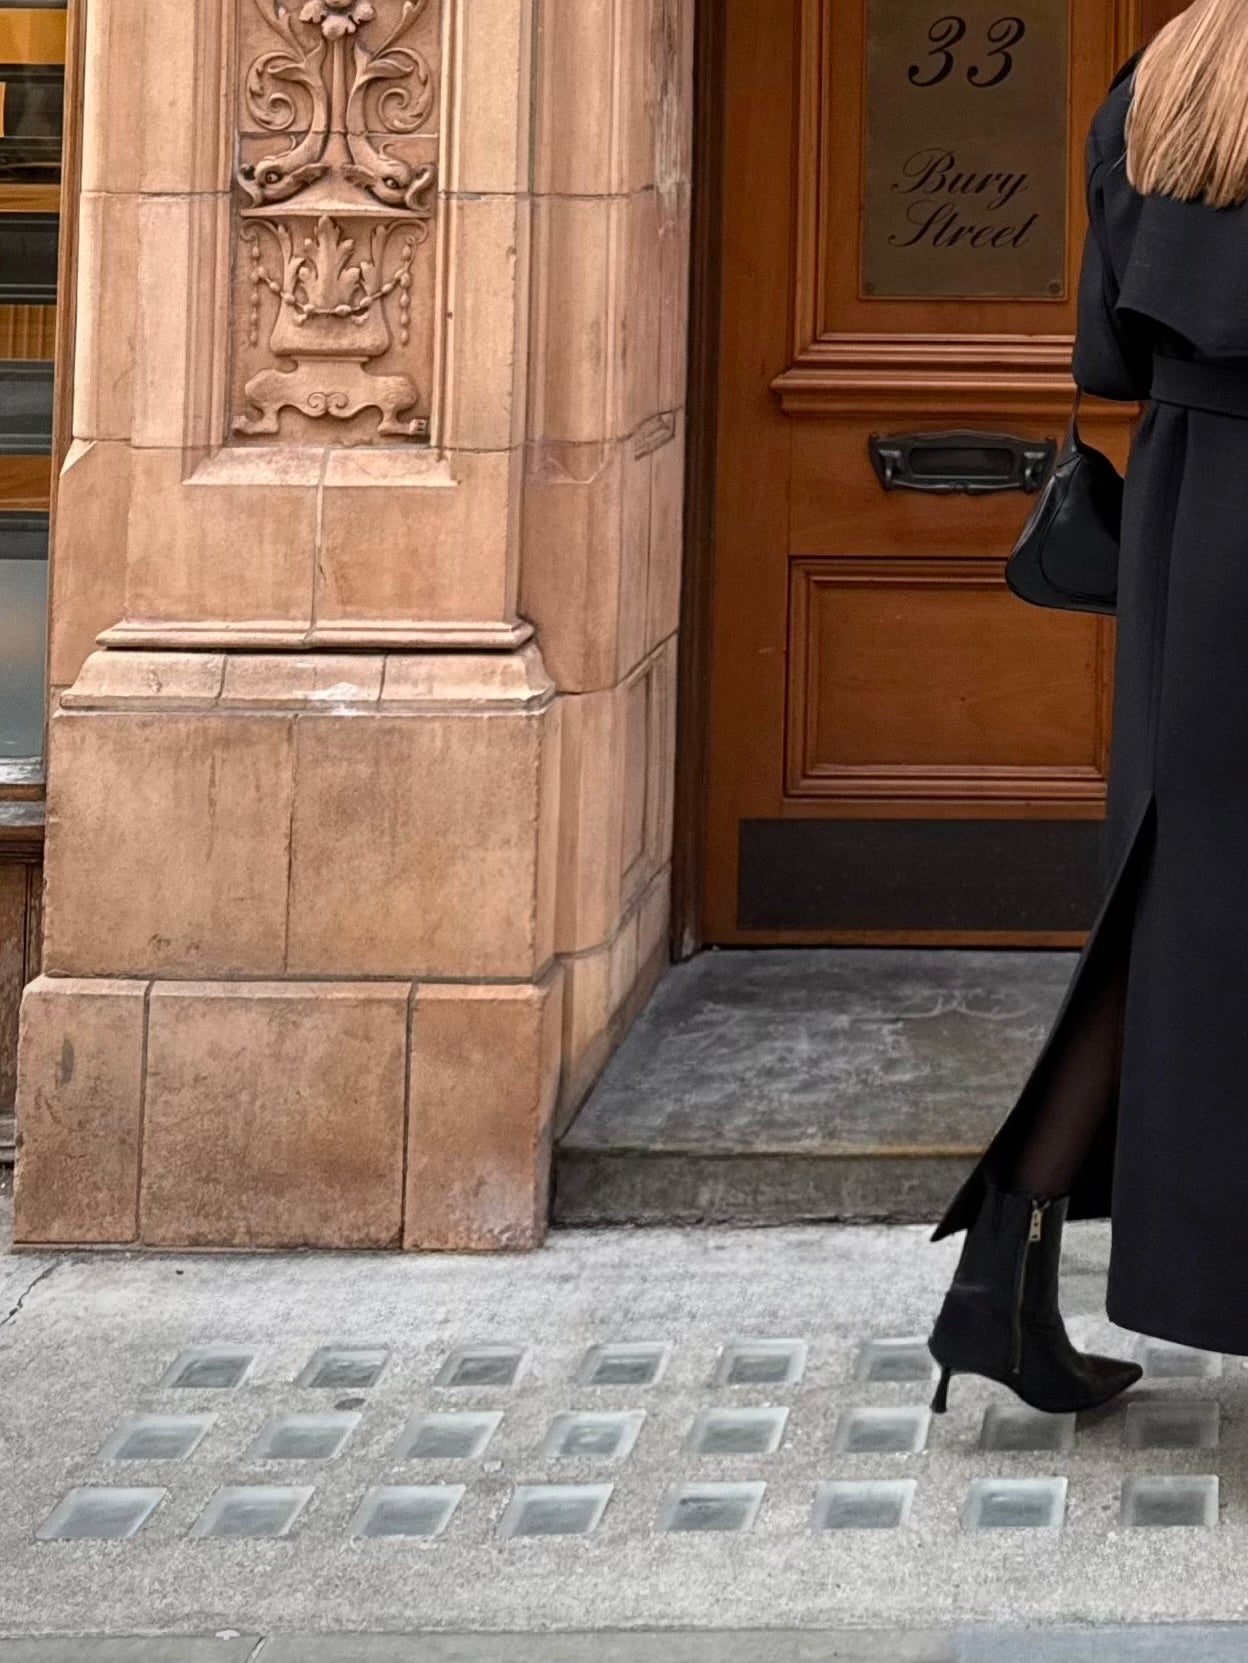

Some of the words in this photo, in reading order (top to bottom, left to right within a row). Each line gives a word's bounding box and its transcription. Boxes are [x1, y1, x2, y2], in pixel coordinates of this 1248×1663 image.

[907, 16, 1026, 87] 33
[890, 148, 1029, 210] Bury
[887, 199, 1038, 249] Street
